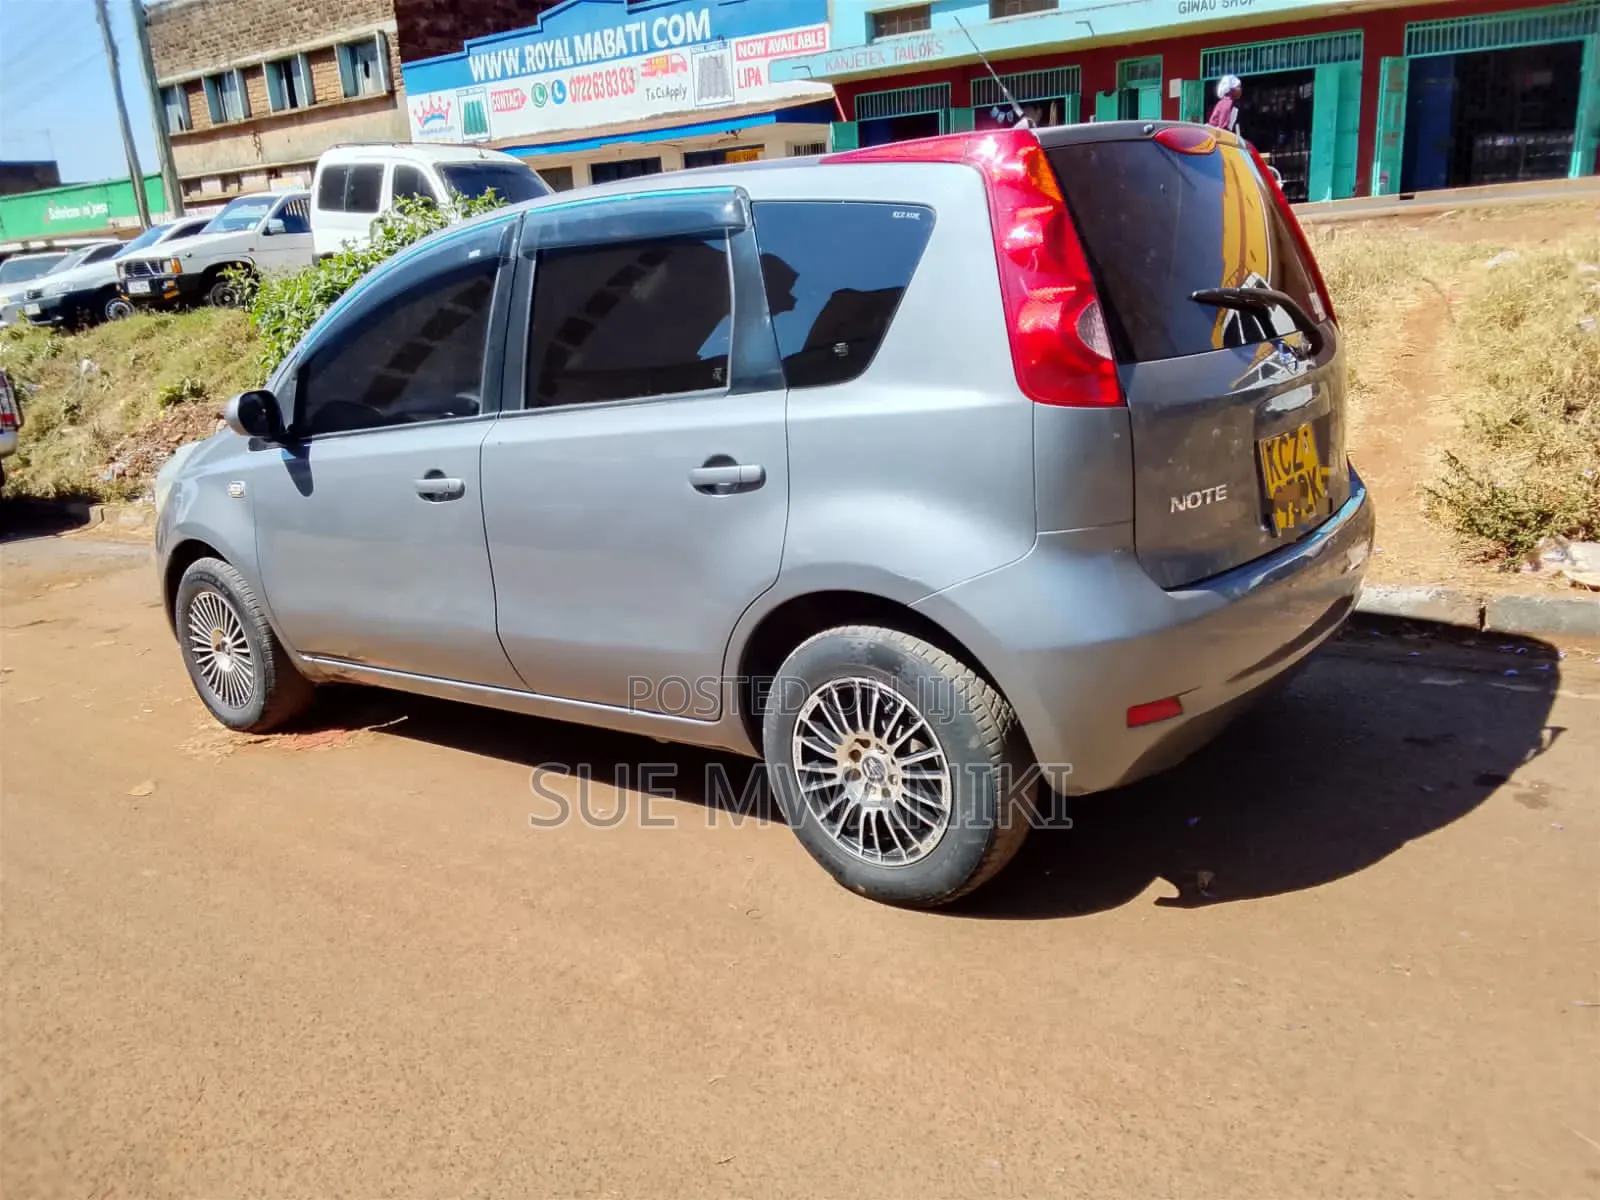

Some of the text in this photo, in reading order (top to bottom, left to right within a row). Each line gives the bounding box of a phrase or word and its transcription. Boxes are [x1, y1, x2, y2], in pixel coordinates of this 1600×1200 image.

[738, 41, 765, 57] NOW
[768, 31, 825, 51] AVAILABLE
[737, 66, 762, 89] LIPA
[1170, 484, 1227, 513] NOTE
